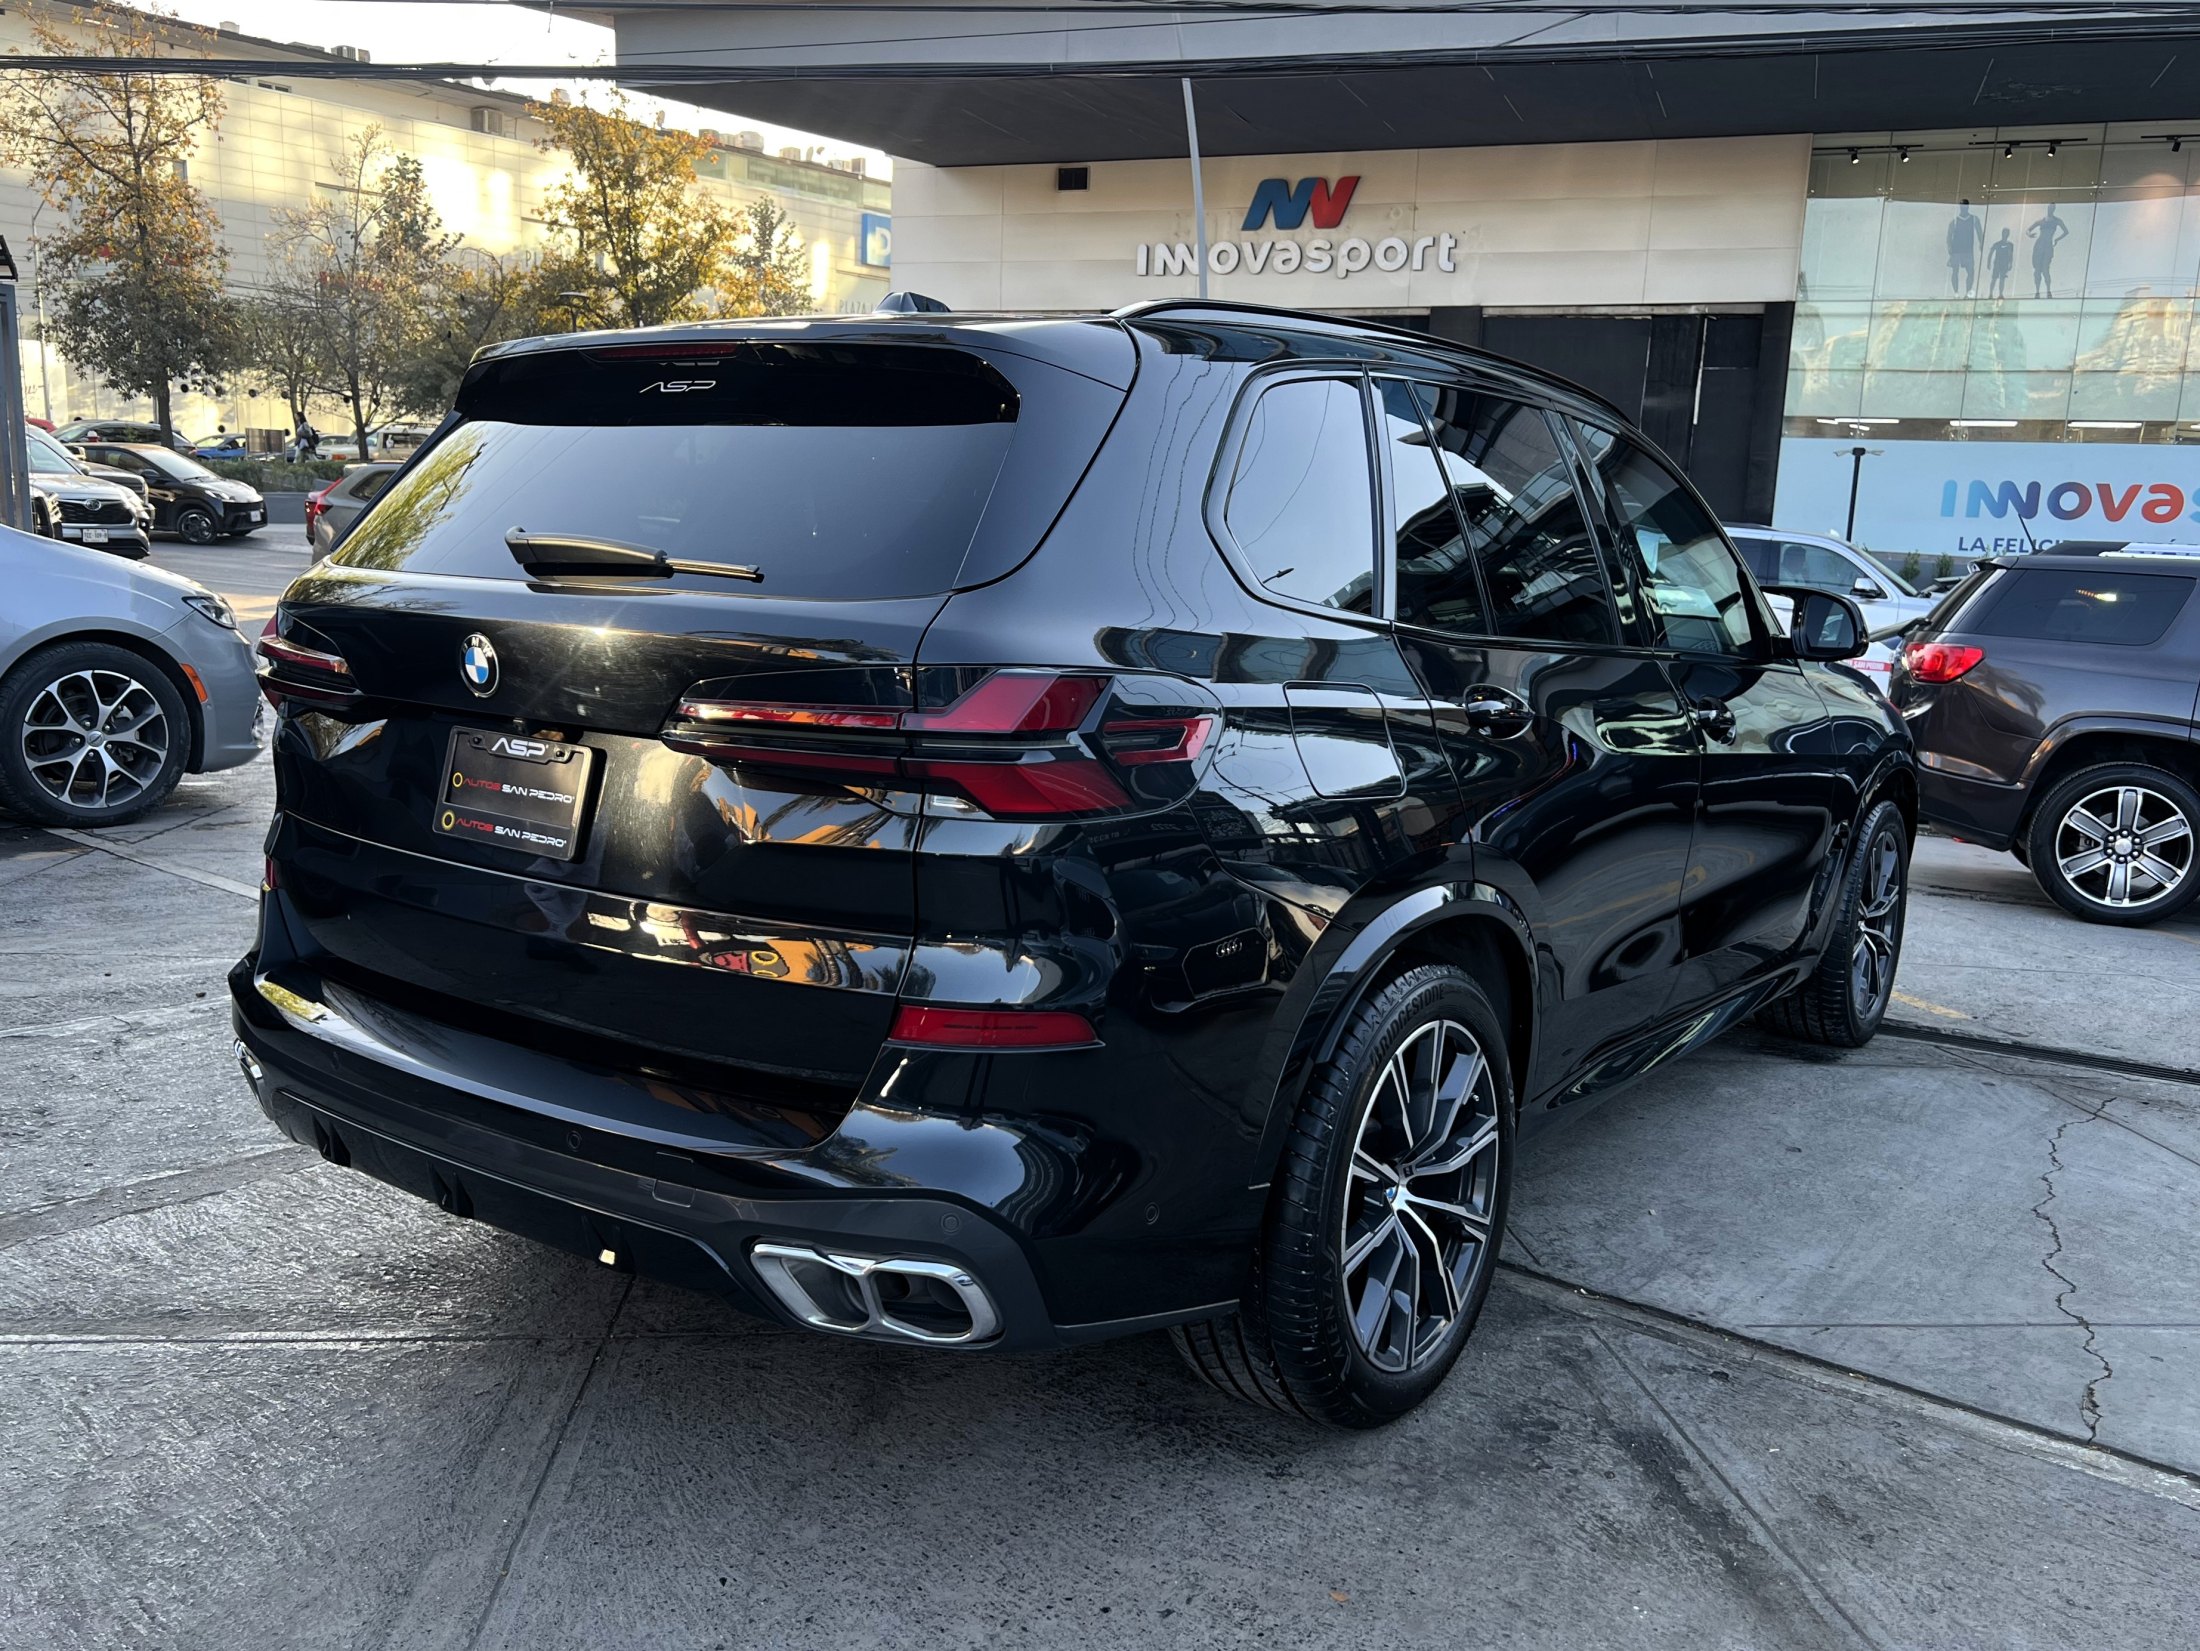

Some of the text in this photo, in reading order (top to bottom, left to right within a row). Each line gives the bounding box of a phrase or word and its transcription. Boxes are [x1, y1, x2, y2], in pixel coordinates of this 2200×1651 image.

[1958, 536, 1986, 552] LA
[491, 737, 546, 758] ASP
[463, 777, 575, 804] AUTOS SAN PEDRO
[456, 817, 567, 848] AUTOS SAN PEDRO
[1372, 983, 1445, 1069] BRIDGESTONE
